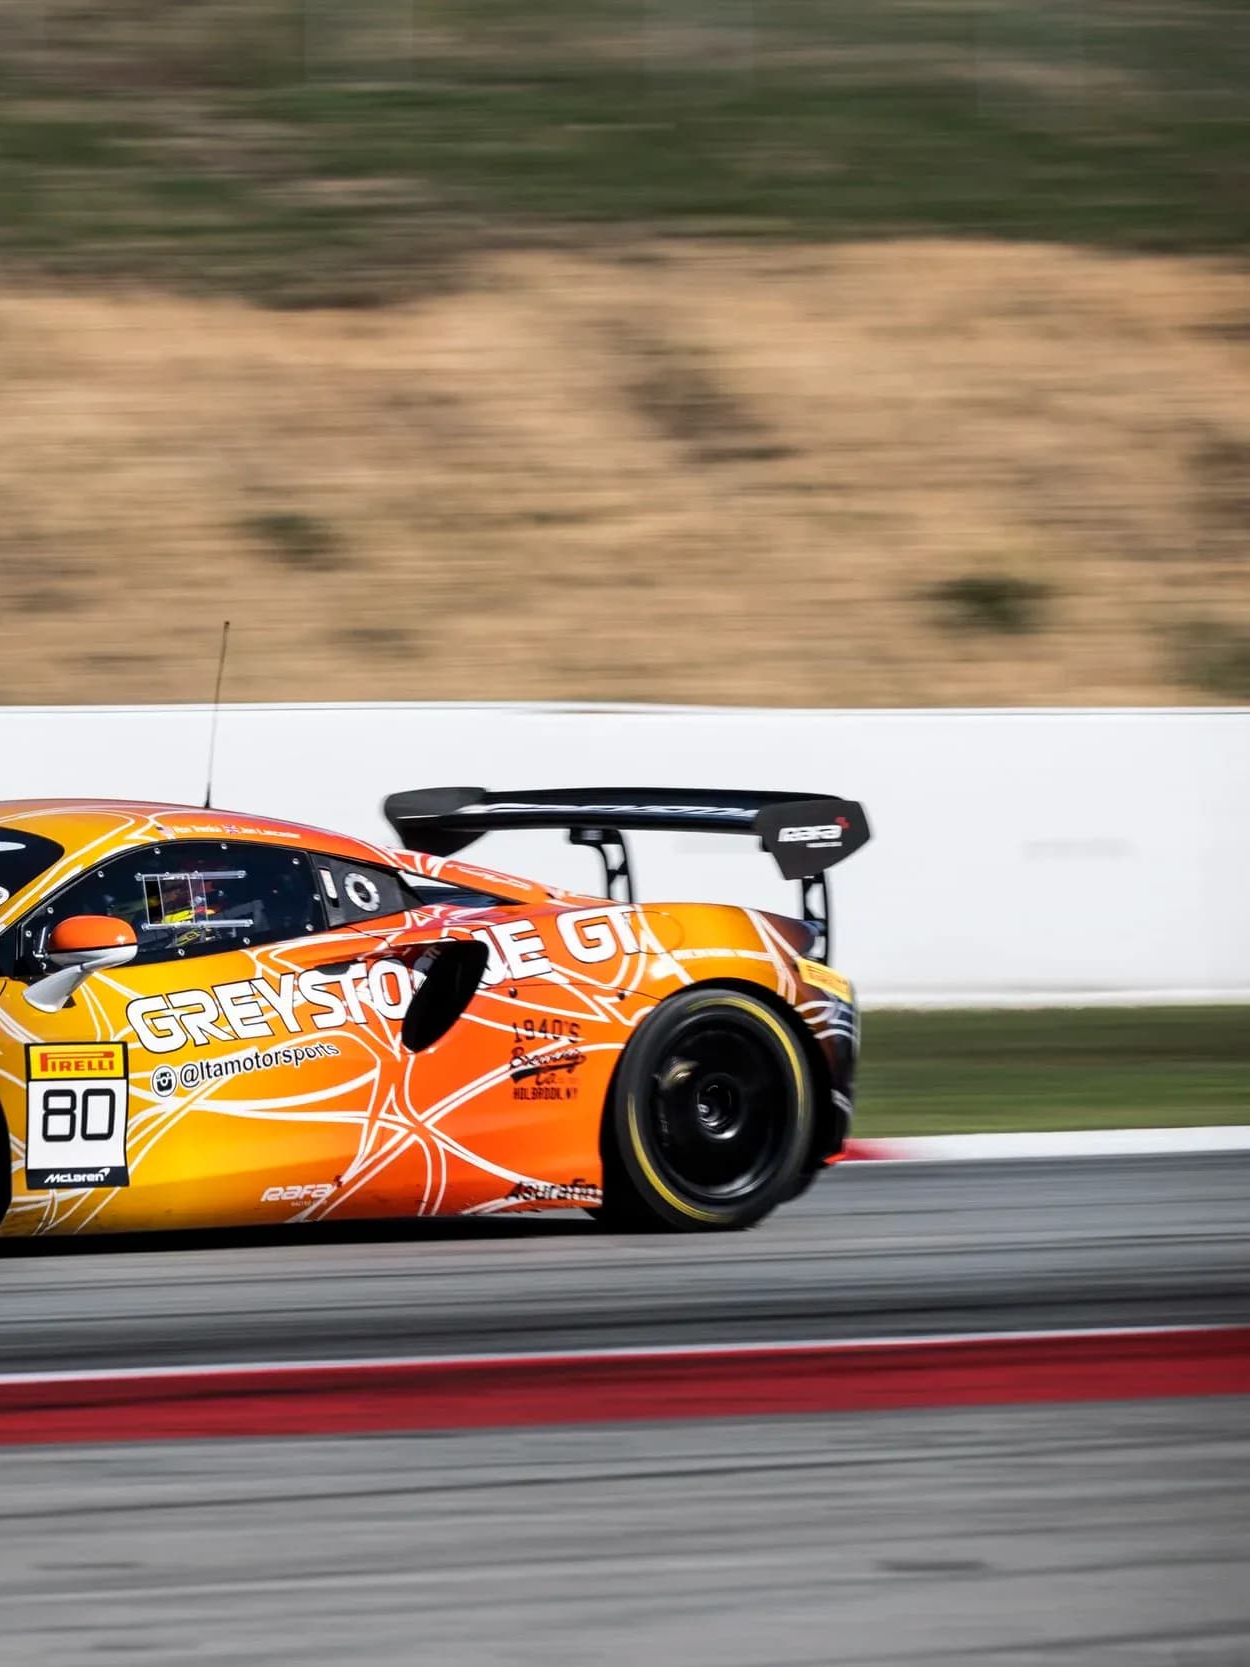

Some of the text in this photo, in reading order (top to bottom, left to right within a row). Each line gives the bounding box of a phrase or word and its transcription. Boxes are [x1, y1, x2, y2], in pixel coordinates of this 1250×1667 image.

[556, 905, 640, 964] GT
[40, 1051, 115, 1072] PIRELLI
[181, 1042, 340, 1087] @ltamotorsports
[42, 1088, 116, 1142] 80
[44, 1172, 106, 1184] McLaren
